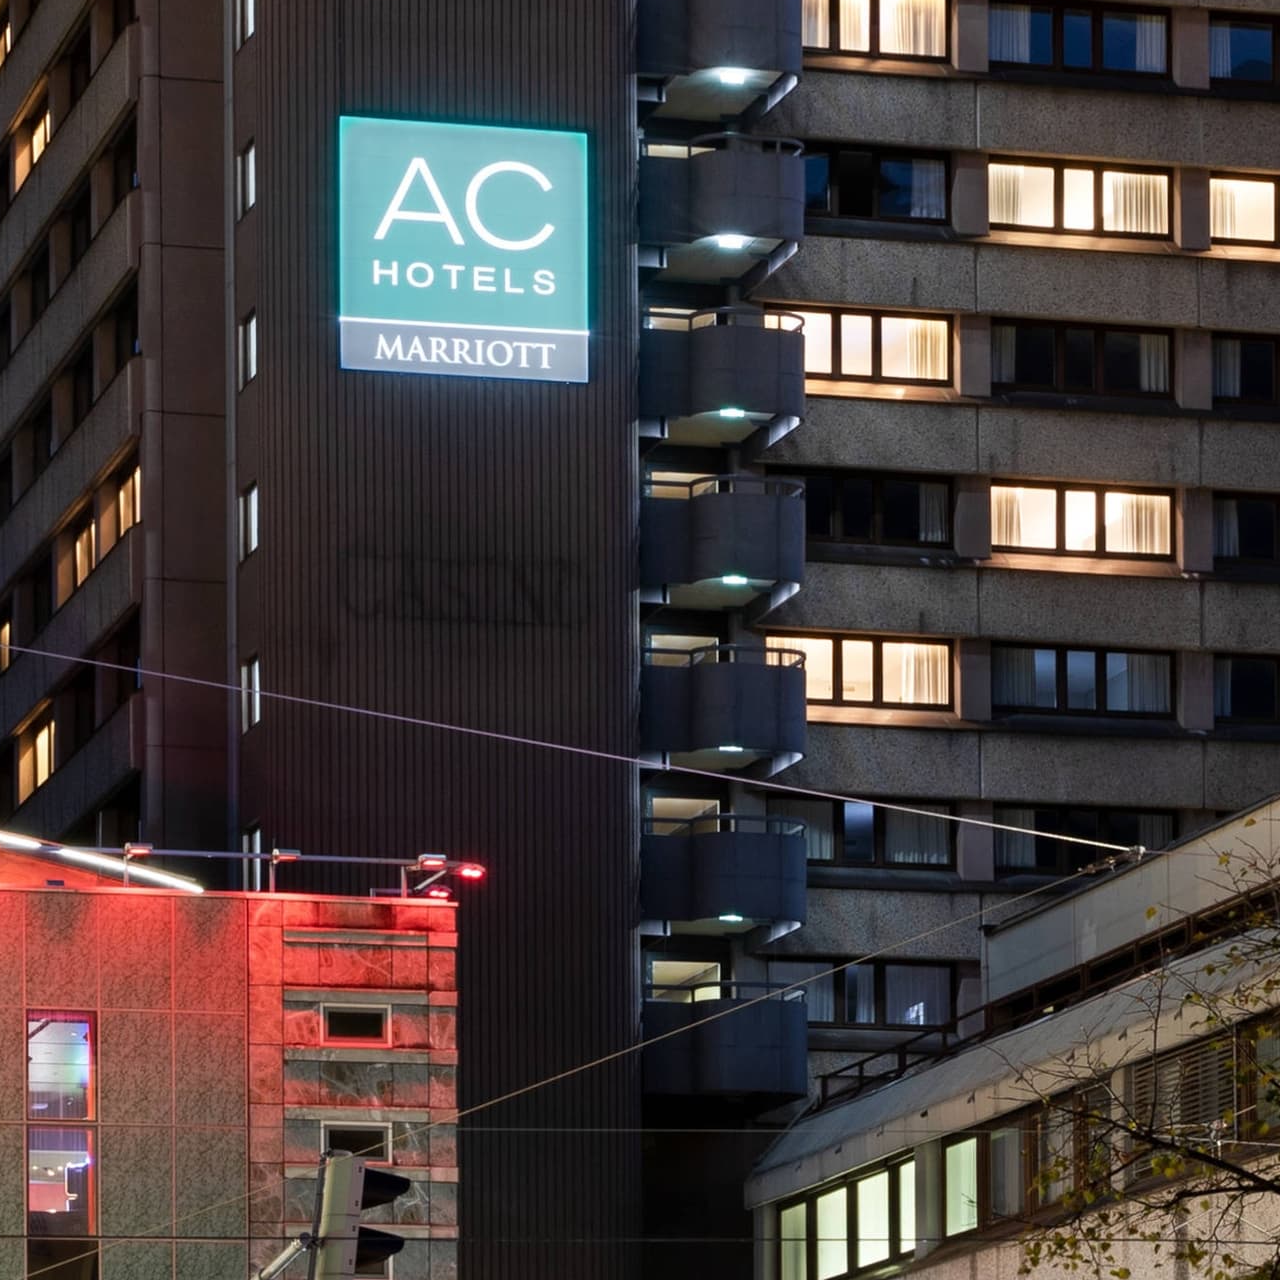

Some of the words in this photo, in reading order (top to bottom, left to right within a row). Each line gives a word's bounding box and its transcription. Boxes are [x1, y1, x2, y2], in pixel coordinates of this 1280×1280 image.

[373, 157, 555, 251] AC
[373, 260, 556, 295] HOTELS
[375, 334, 556, 369] MARRIOTT
